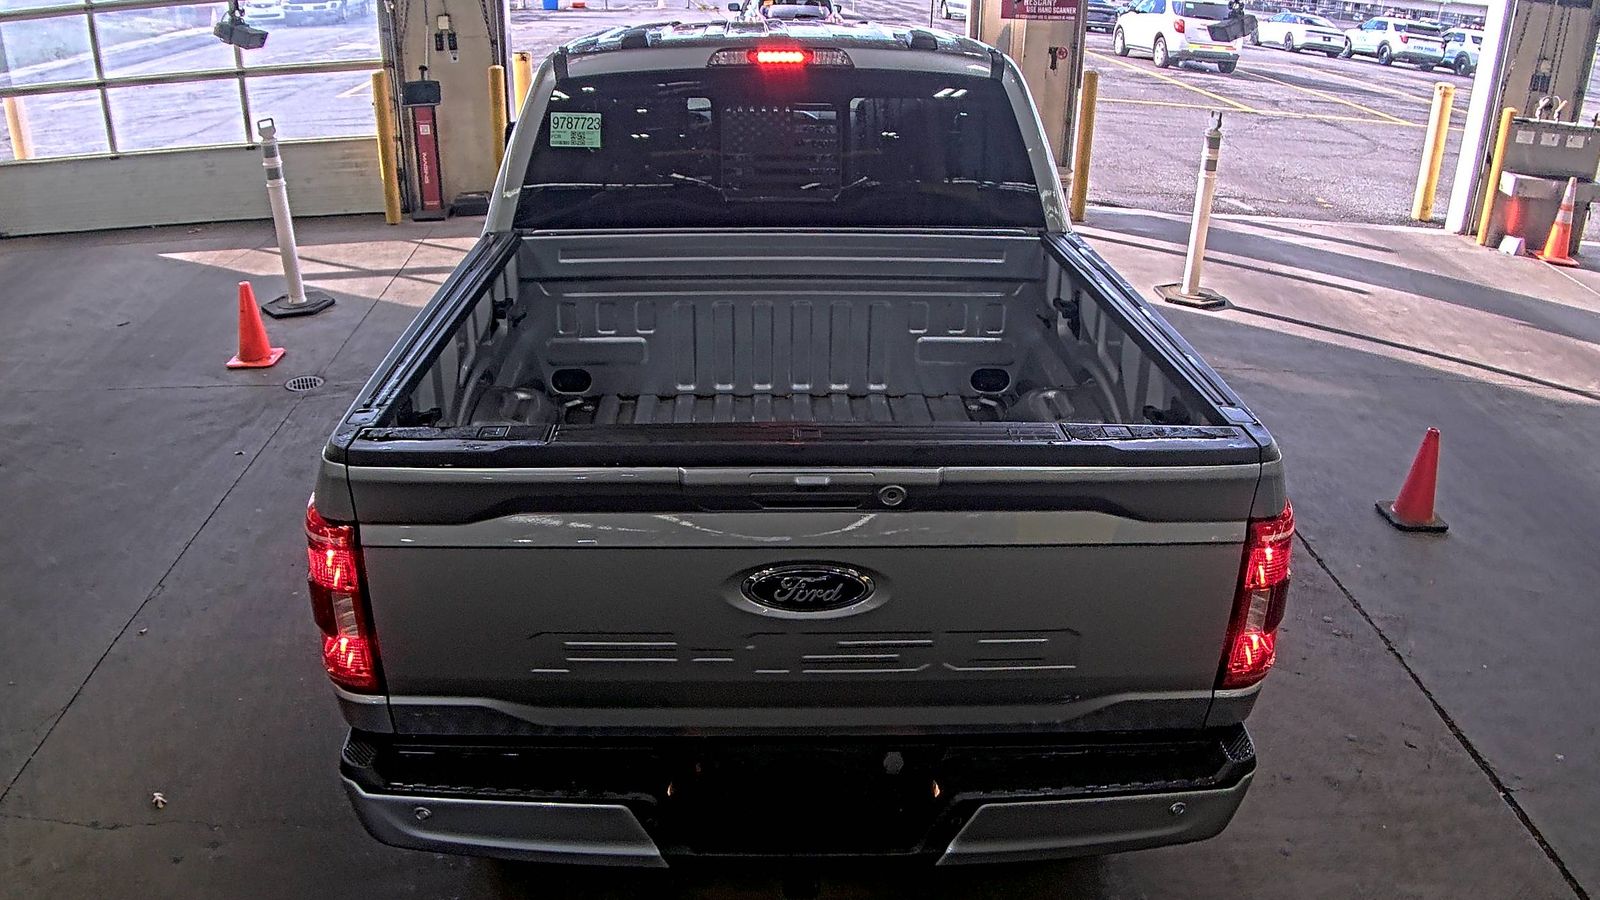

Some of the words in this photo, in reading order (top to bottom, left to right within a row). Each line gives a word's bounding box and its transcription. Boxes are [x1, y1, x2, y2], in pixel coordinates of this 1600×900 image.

[1037, 6, 1052, 14] HAND
[1052, 6, 1077, 14] SCANNER
[552, 116, 601, 130] 9787723
[773, 576, 844, 602] Ford
